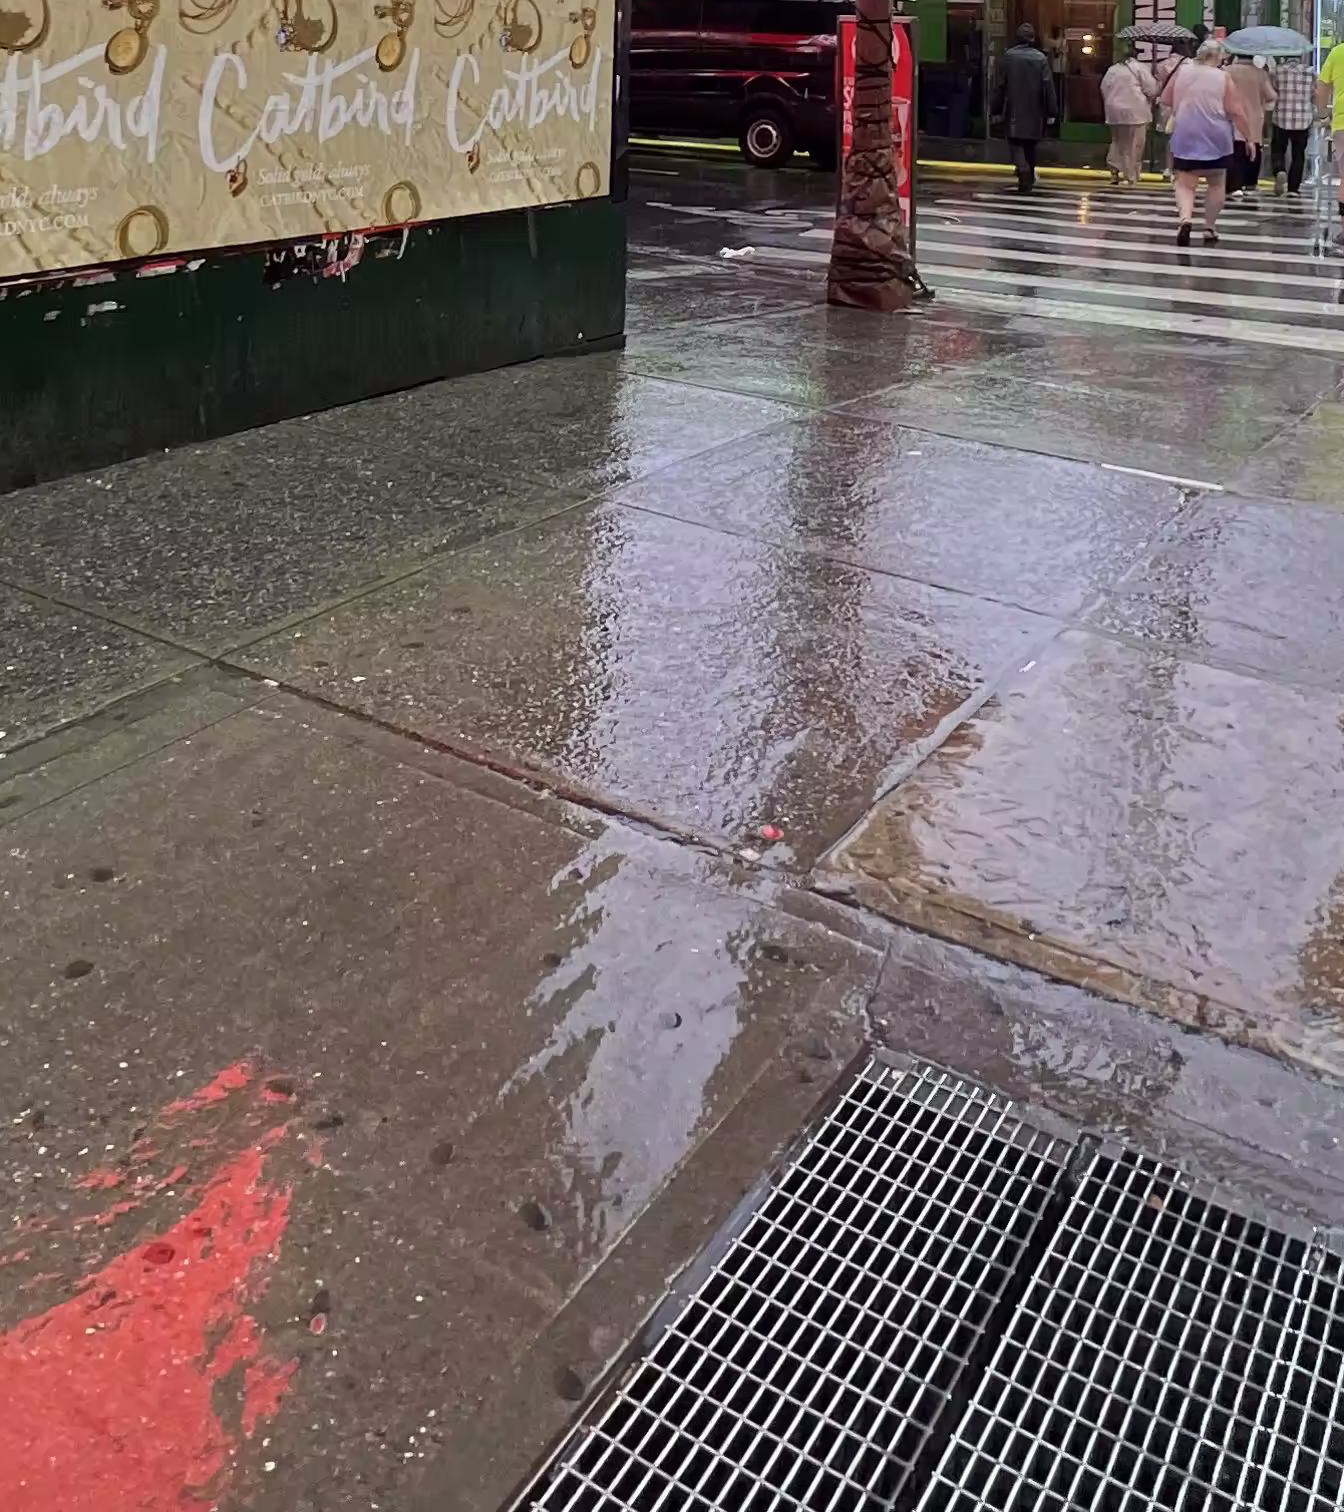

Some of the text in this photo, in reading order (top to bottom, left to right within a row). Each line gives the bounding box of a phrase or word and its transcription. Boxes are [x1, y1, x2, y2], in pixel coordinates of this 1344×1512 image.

[198, 46, 420, 173] Catbird
[446, 46, 601, 153] Catbird
[36, 183, 99, 207] always
